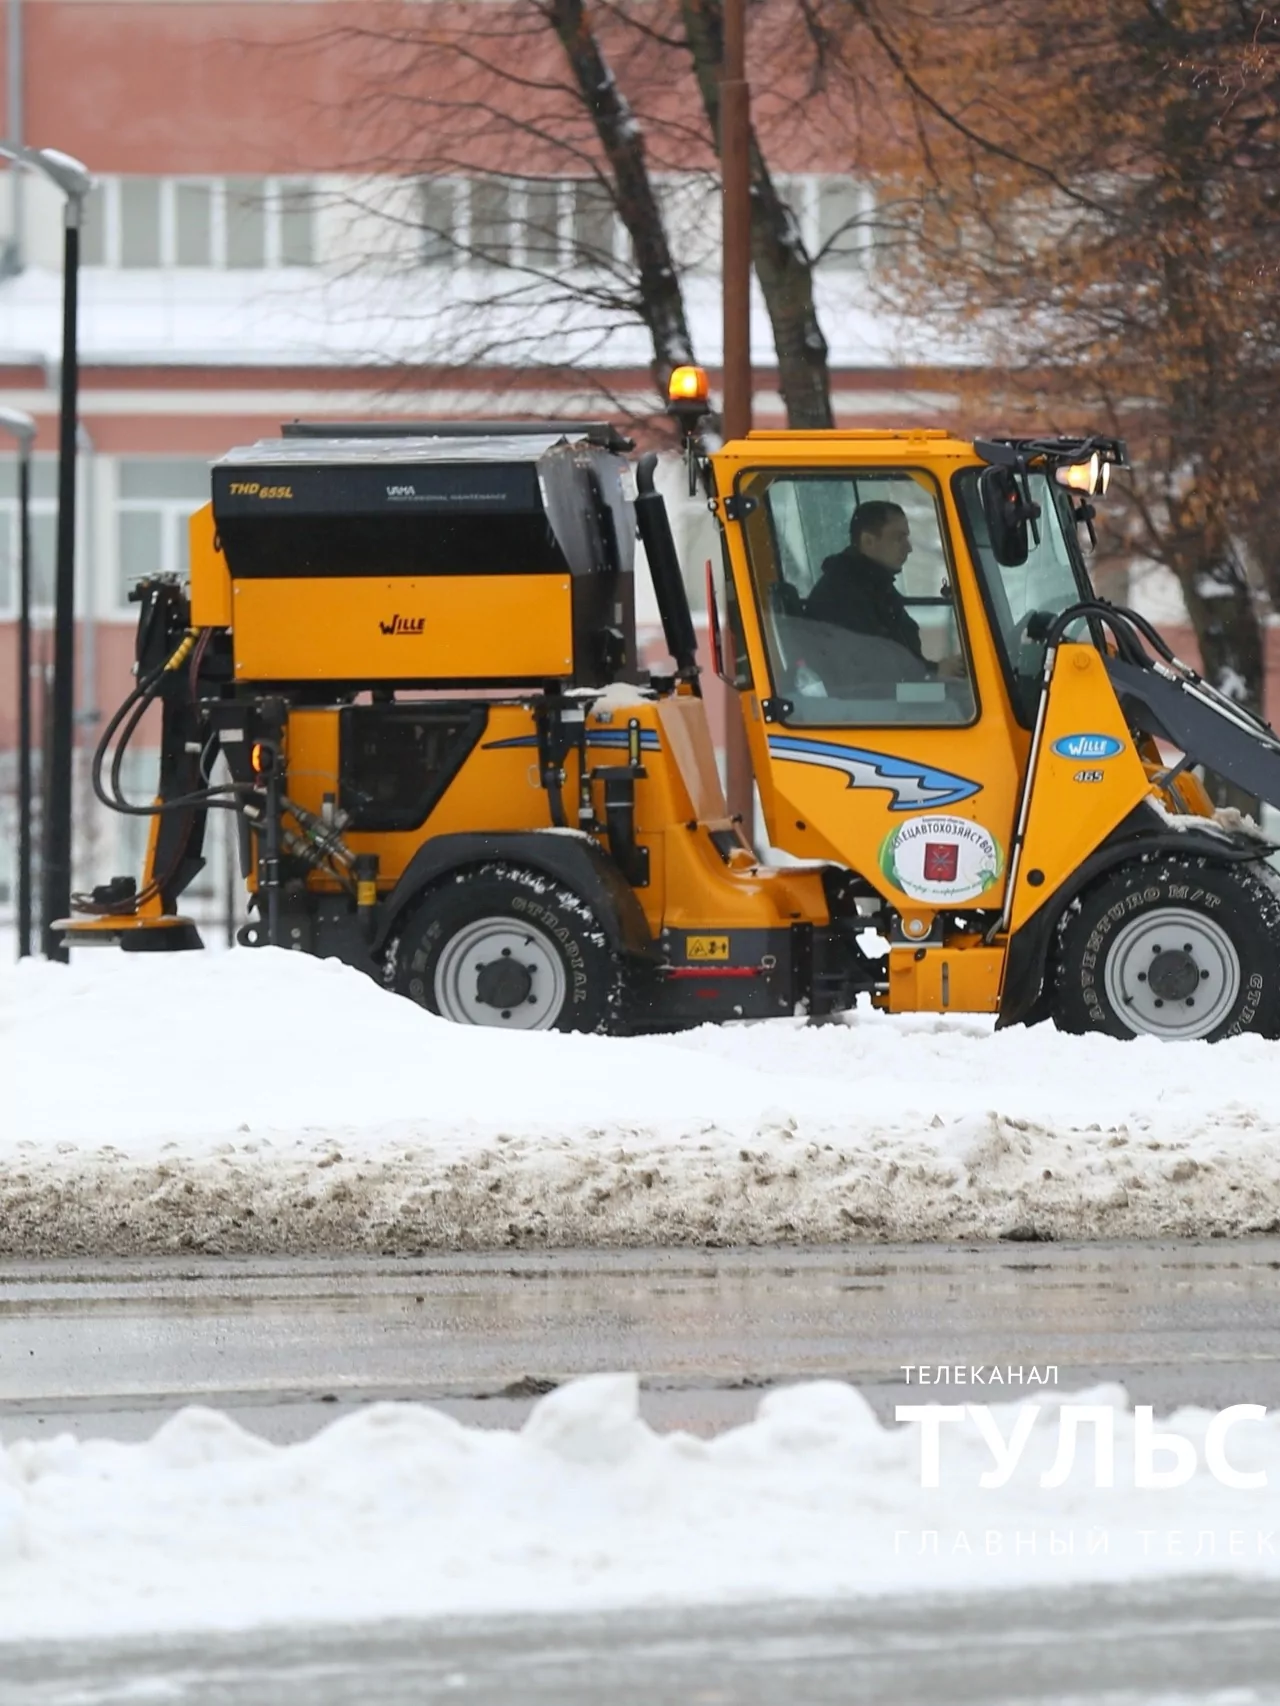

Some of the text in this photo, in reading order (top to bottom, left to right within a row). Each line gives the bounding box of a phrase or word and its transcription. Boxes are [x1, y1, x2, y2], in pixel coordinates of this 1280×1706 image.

[229, 482, 260, 495] THD
[379, 614, 426, 635] WILLE
[1069, 736, 1107, 756] WILLE
[1073, 771, 1104, 782] 465
